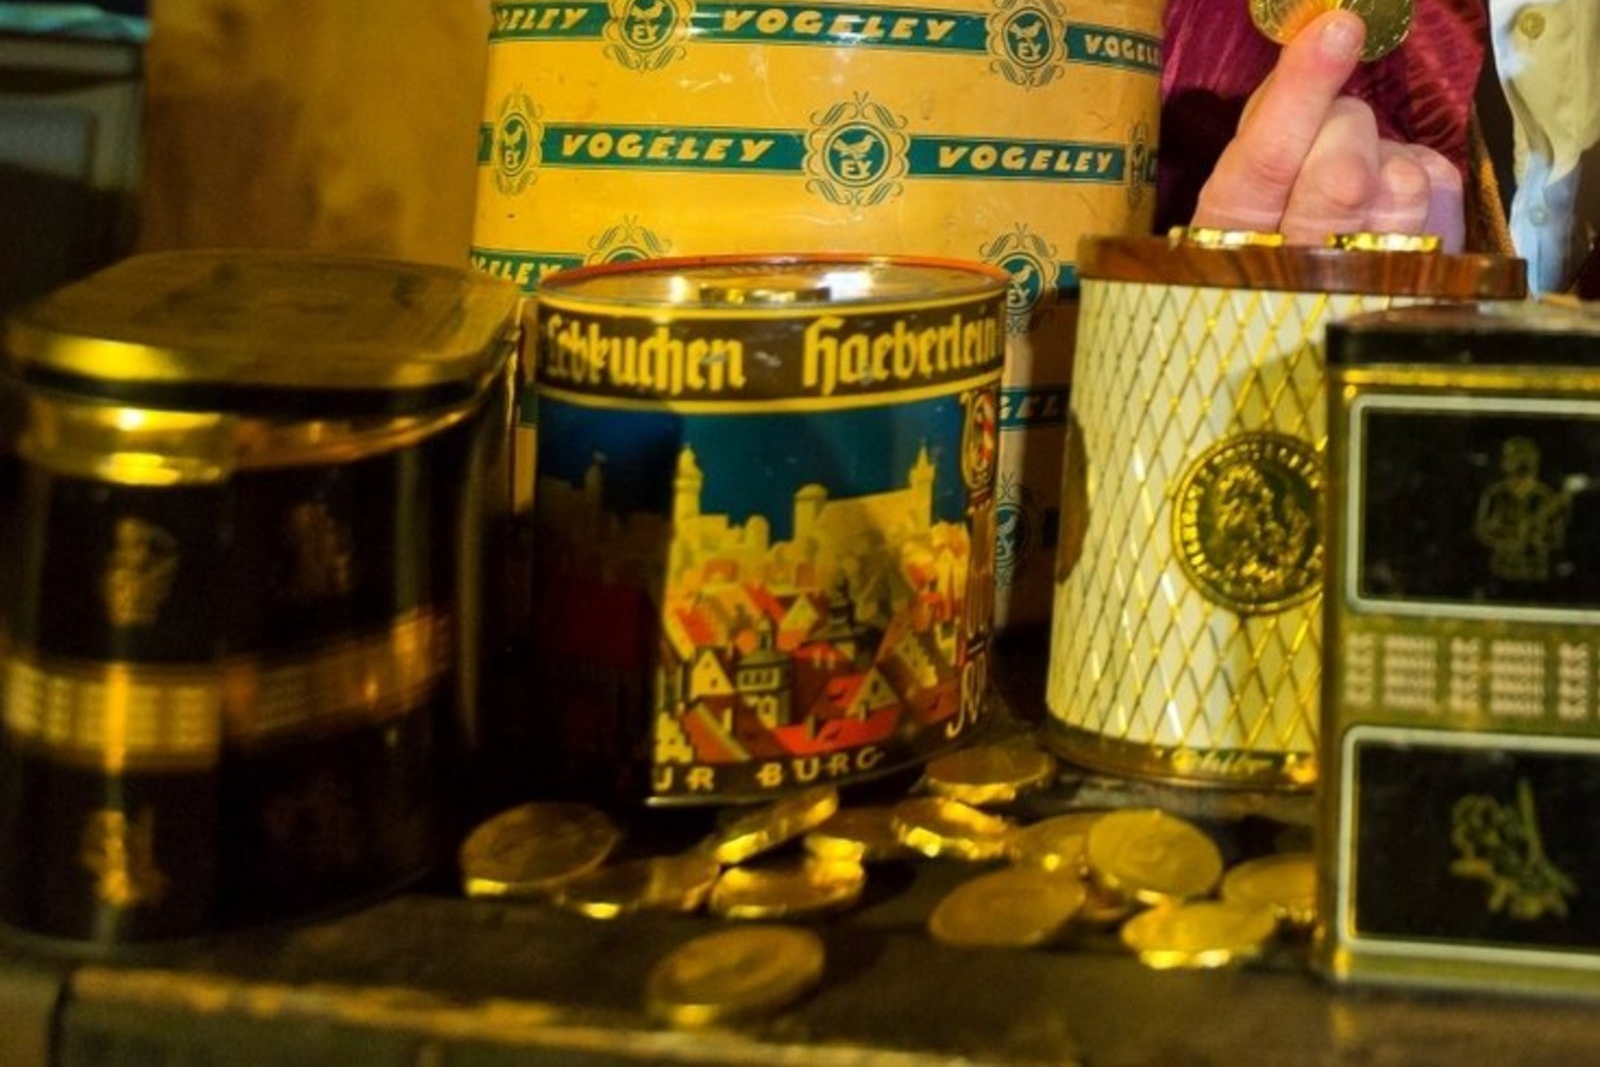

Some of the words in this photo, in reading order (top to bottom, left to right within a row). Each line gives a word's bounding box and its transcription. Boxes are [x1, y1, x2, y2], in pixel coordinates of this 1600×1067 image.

[721, 8, 956, 41] VOGELEY
[561, 132, 775, 162] VOGELEY
[938, 143, 1113, 173] VOGELEY
[756, 745, 885, 788] BURG
